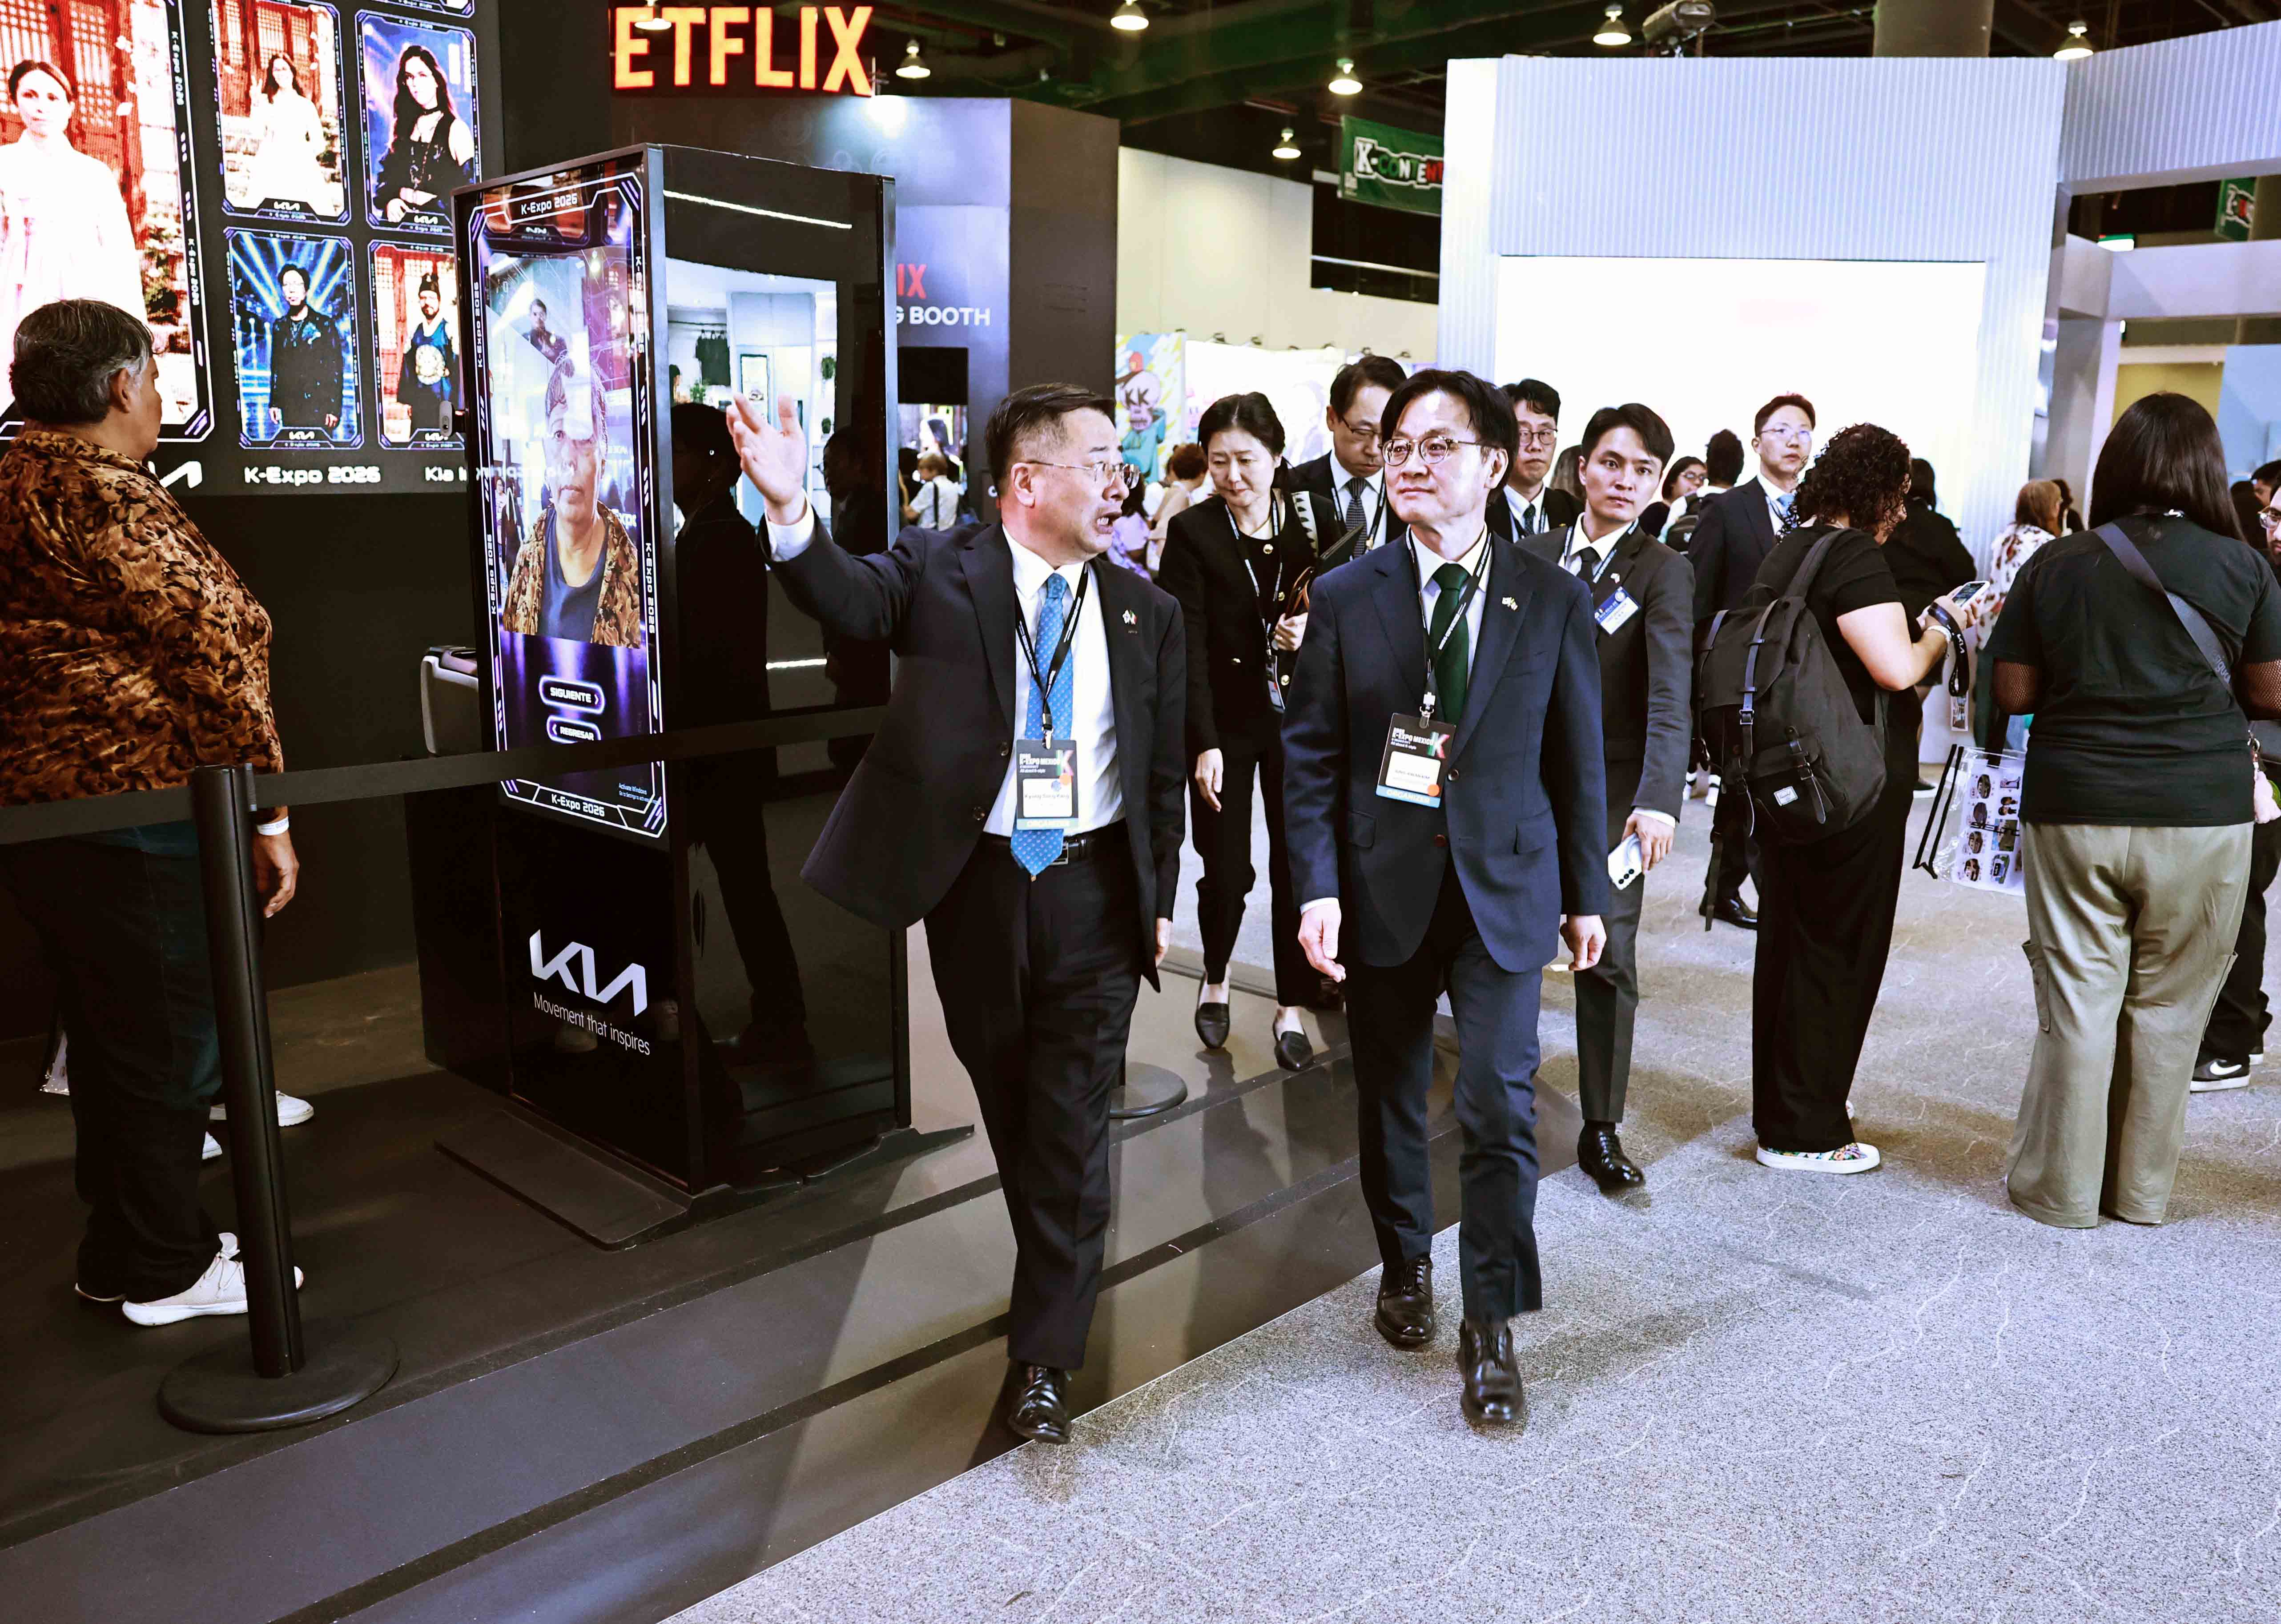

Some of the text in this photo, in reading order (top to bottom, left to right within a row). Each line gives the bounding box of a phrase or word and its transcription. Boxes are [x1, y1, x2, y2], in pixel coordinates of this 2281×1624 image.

[615, 6, 873, 96] ETFLIX
[521, 193, 577, 215] K-Expo 2026
[909, 306, 990, 326] BOOTH
[244, 466, 382, 487] K-Expo 2026
[550, 687, 592, 703] SIGUIENTE
[560, 726, 595, 741] REGRESAR
[551, 793, 605, 817] K-Expo 2026
[534, 992, 650, 1055] Movement that inspires
